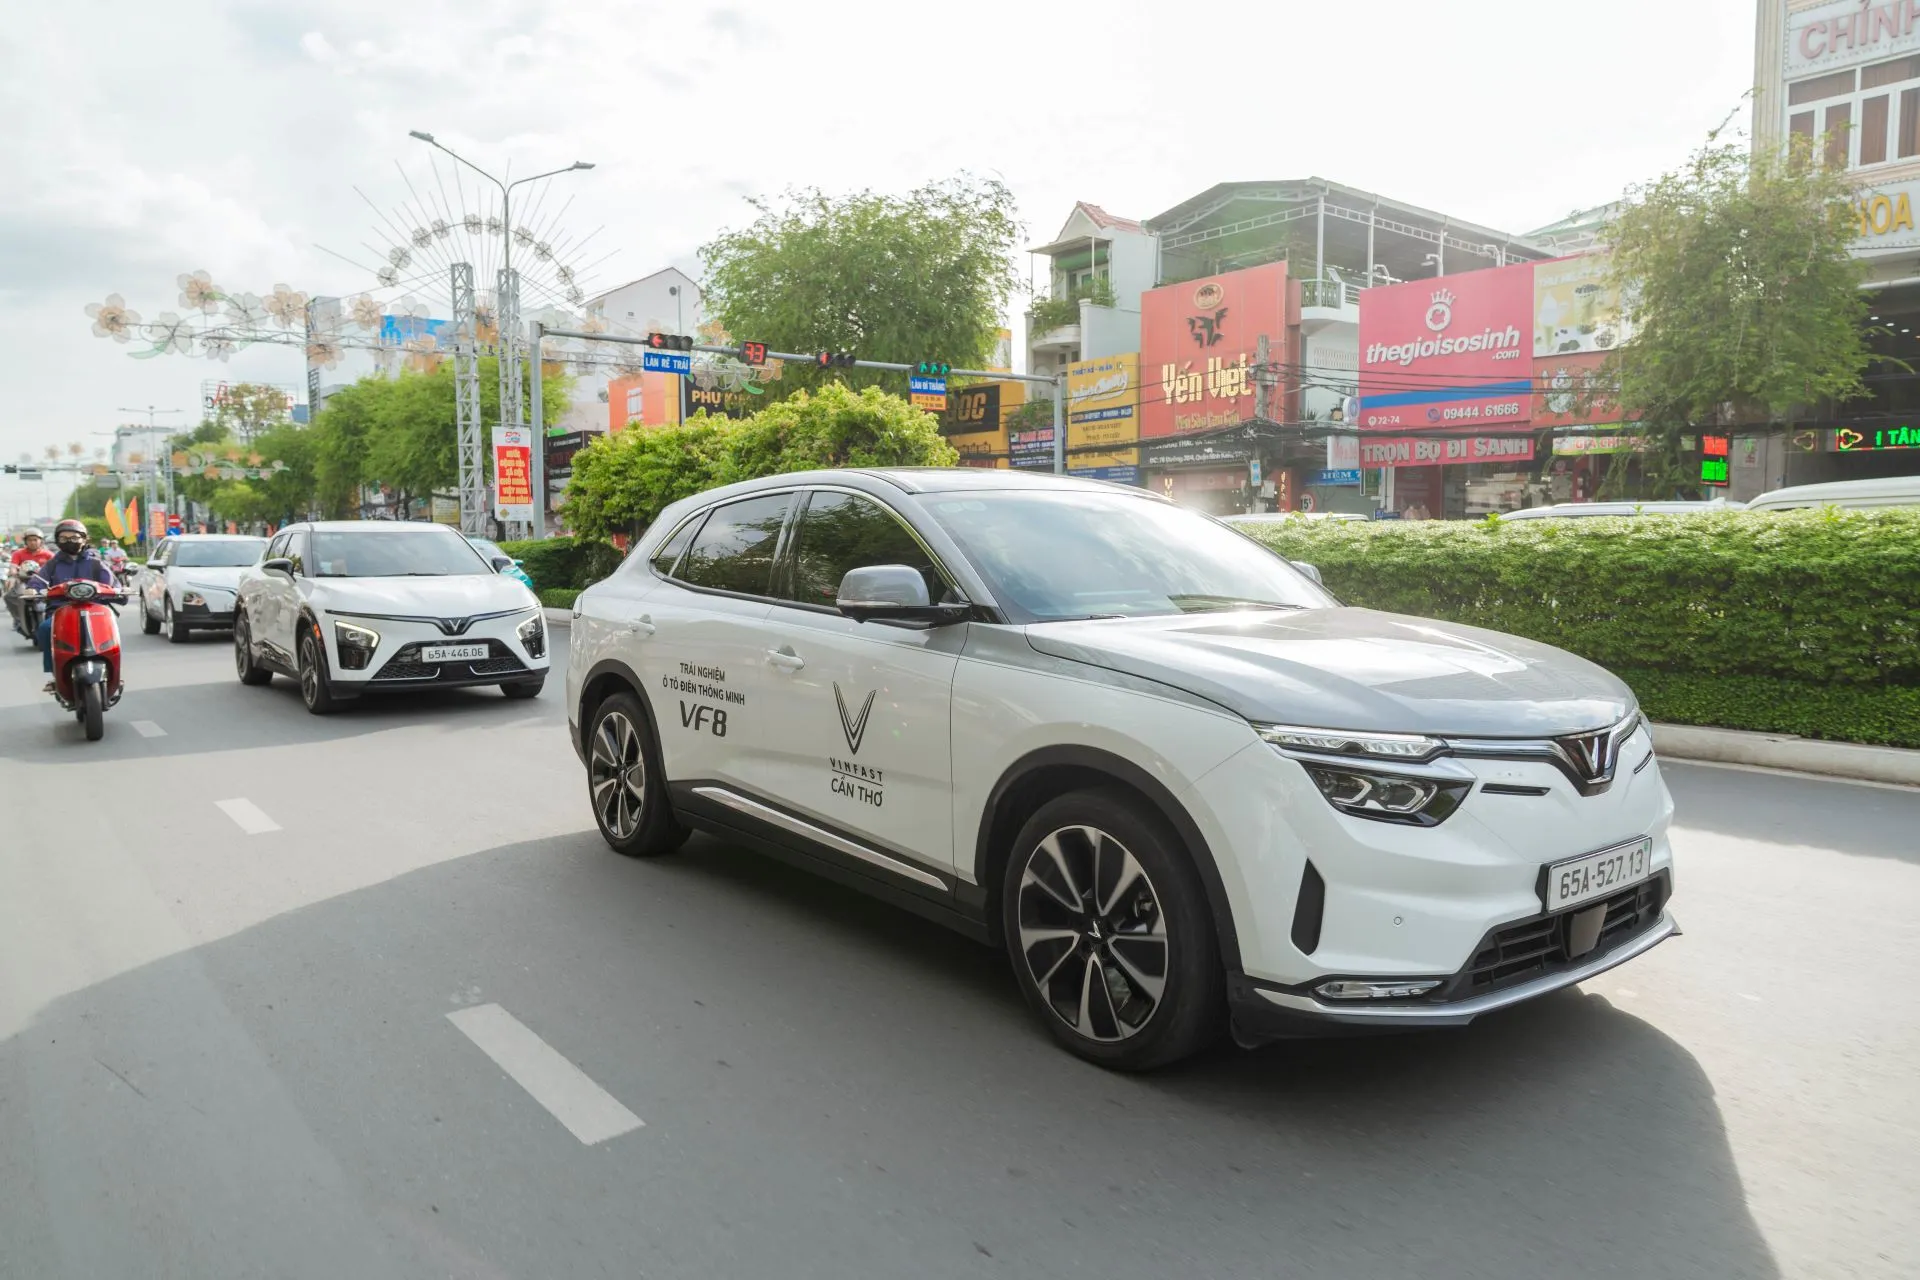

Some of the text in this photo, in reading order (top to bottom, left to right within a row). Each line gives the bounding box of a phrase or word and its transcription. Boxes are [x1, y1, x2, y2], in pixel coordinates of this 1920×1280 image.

[1366, 325, 1520, 366] thegioisosinh
[673, 358, 689, 370] TRÁI
[1162, 360, 1202, 405] Yến
[1208, 353, 1252, 404] Việt
[691, 390, 720, 408] PHỤ
[1361, 442, 1410, 465] TRỌN
[1447, 439, 1467, 458] ĐI
[428, 647, 484, 659] 65A-446.06
[679, 661, 725, 683] TRẢI NGHIỆM
[698, 684, 724, 701] THÔNG
[725, 690, 745, 705] MINH
[679, 700, 727, 738] VF8
[830, 756, 883, 782] VINFAST
[831, 774, 883, 807] CẦN THƠ
[1560, 848, 1644, 900] 65A-527.13
